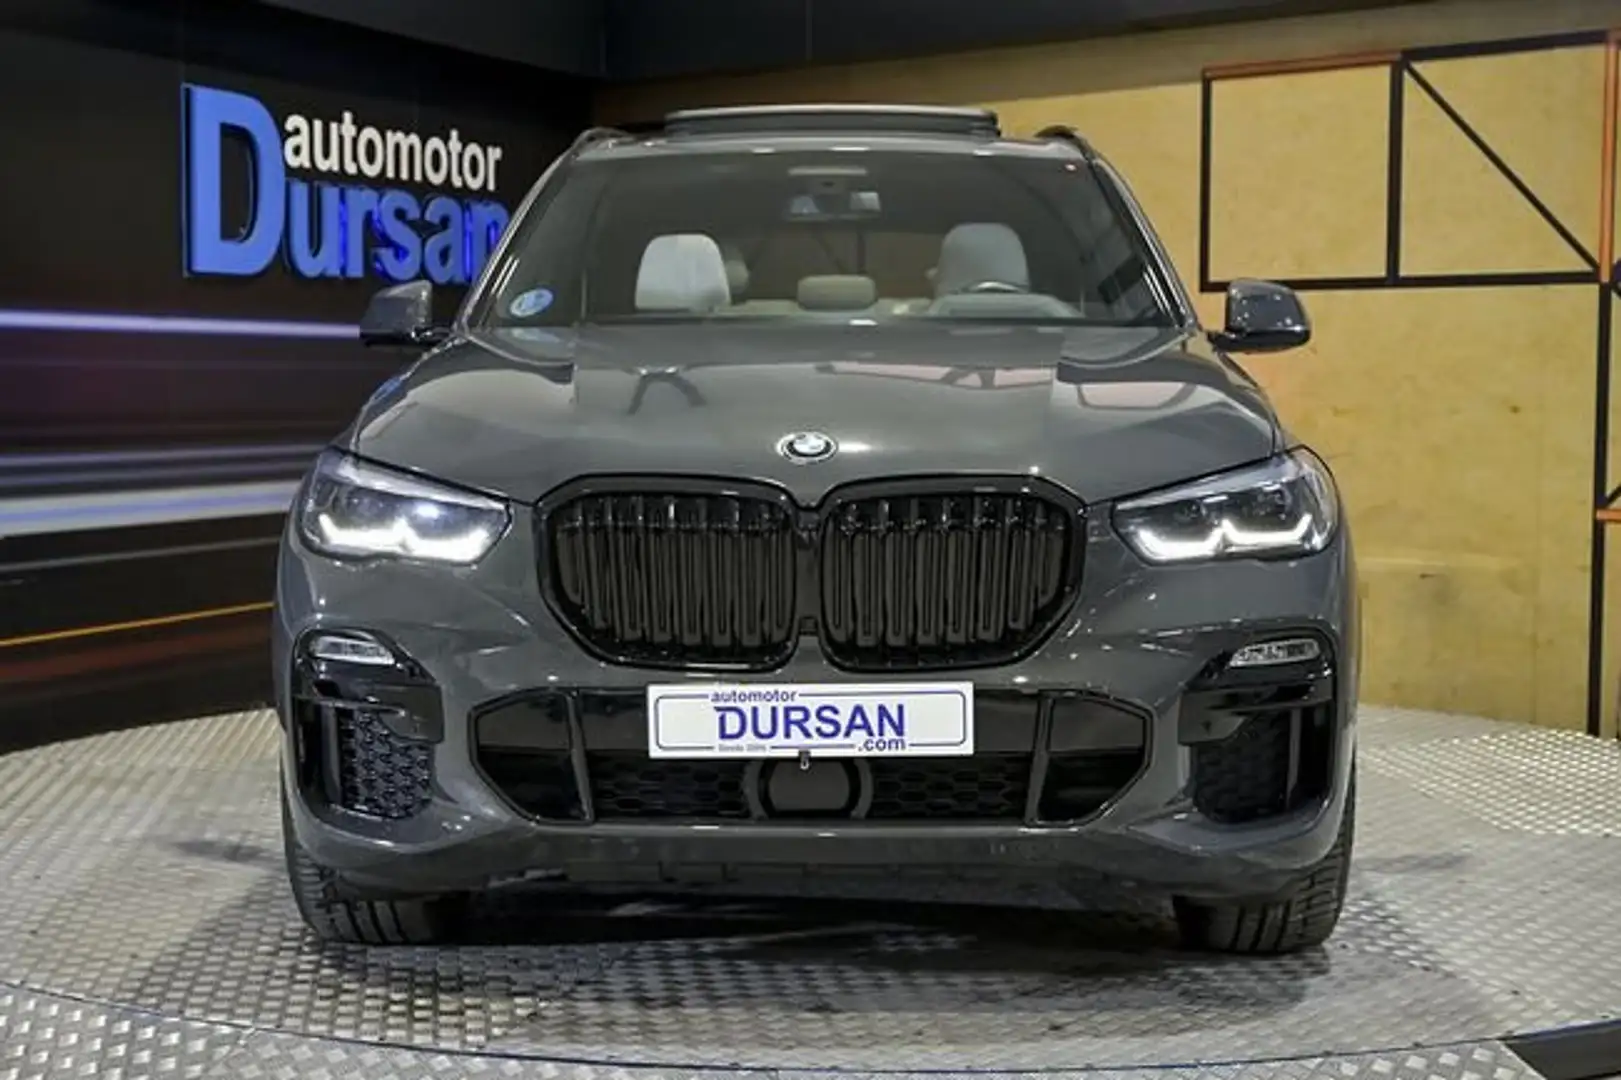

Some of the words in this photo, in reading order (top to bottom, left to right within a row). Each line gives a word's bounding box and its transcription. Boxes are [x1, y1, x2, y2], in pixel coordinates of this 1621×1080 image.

[284, 111, 502, 191] automotor
[182, 83, 509, 284] Dursan
[711, 689, 797, 703] automotor
[713, 703, 905, 740] DURSAN
[858, 737, 906, 752] .com
